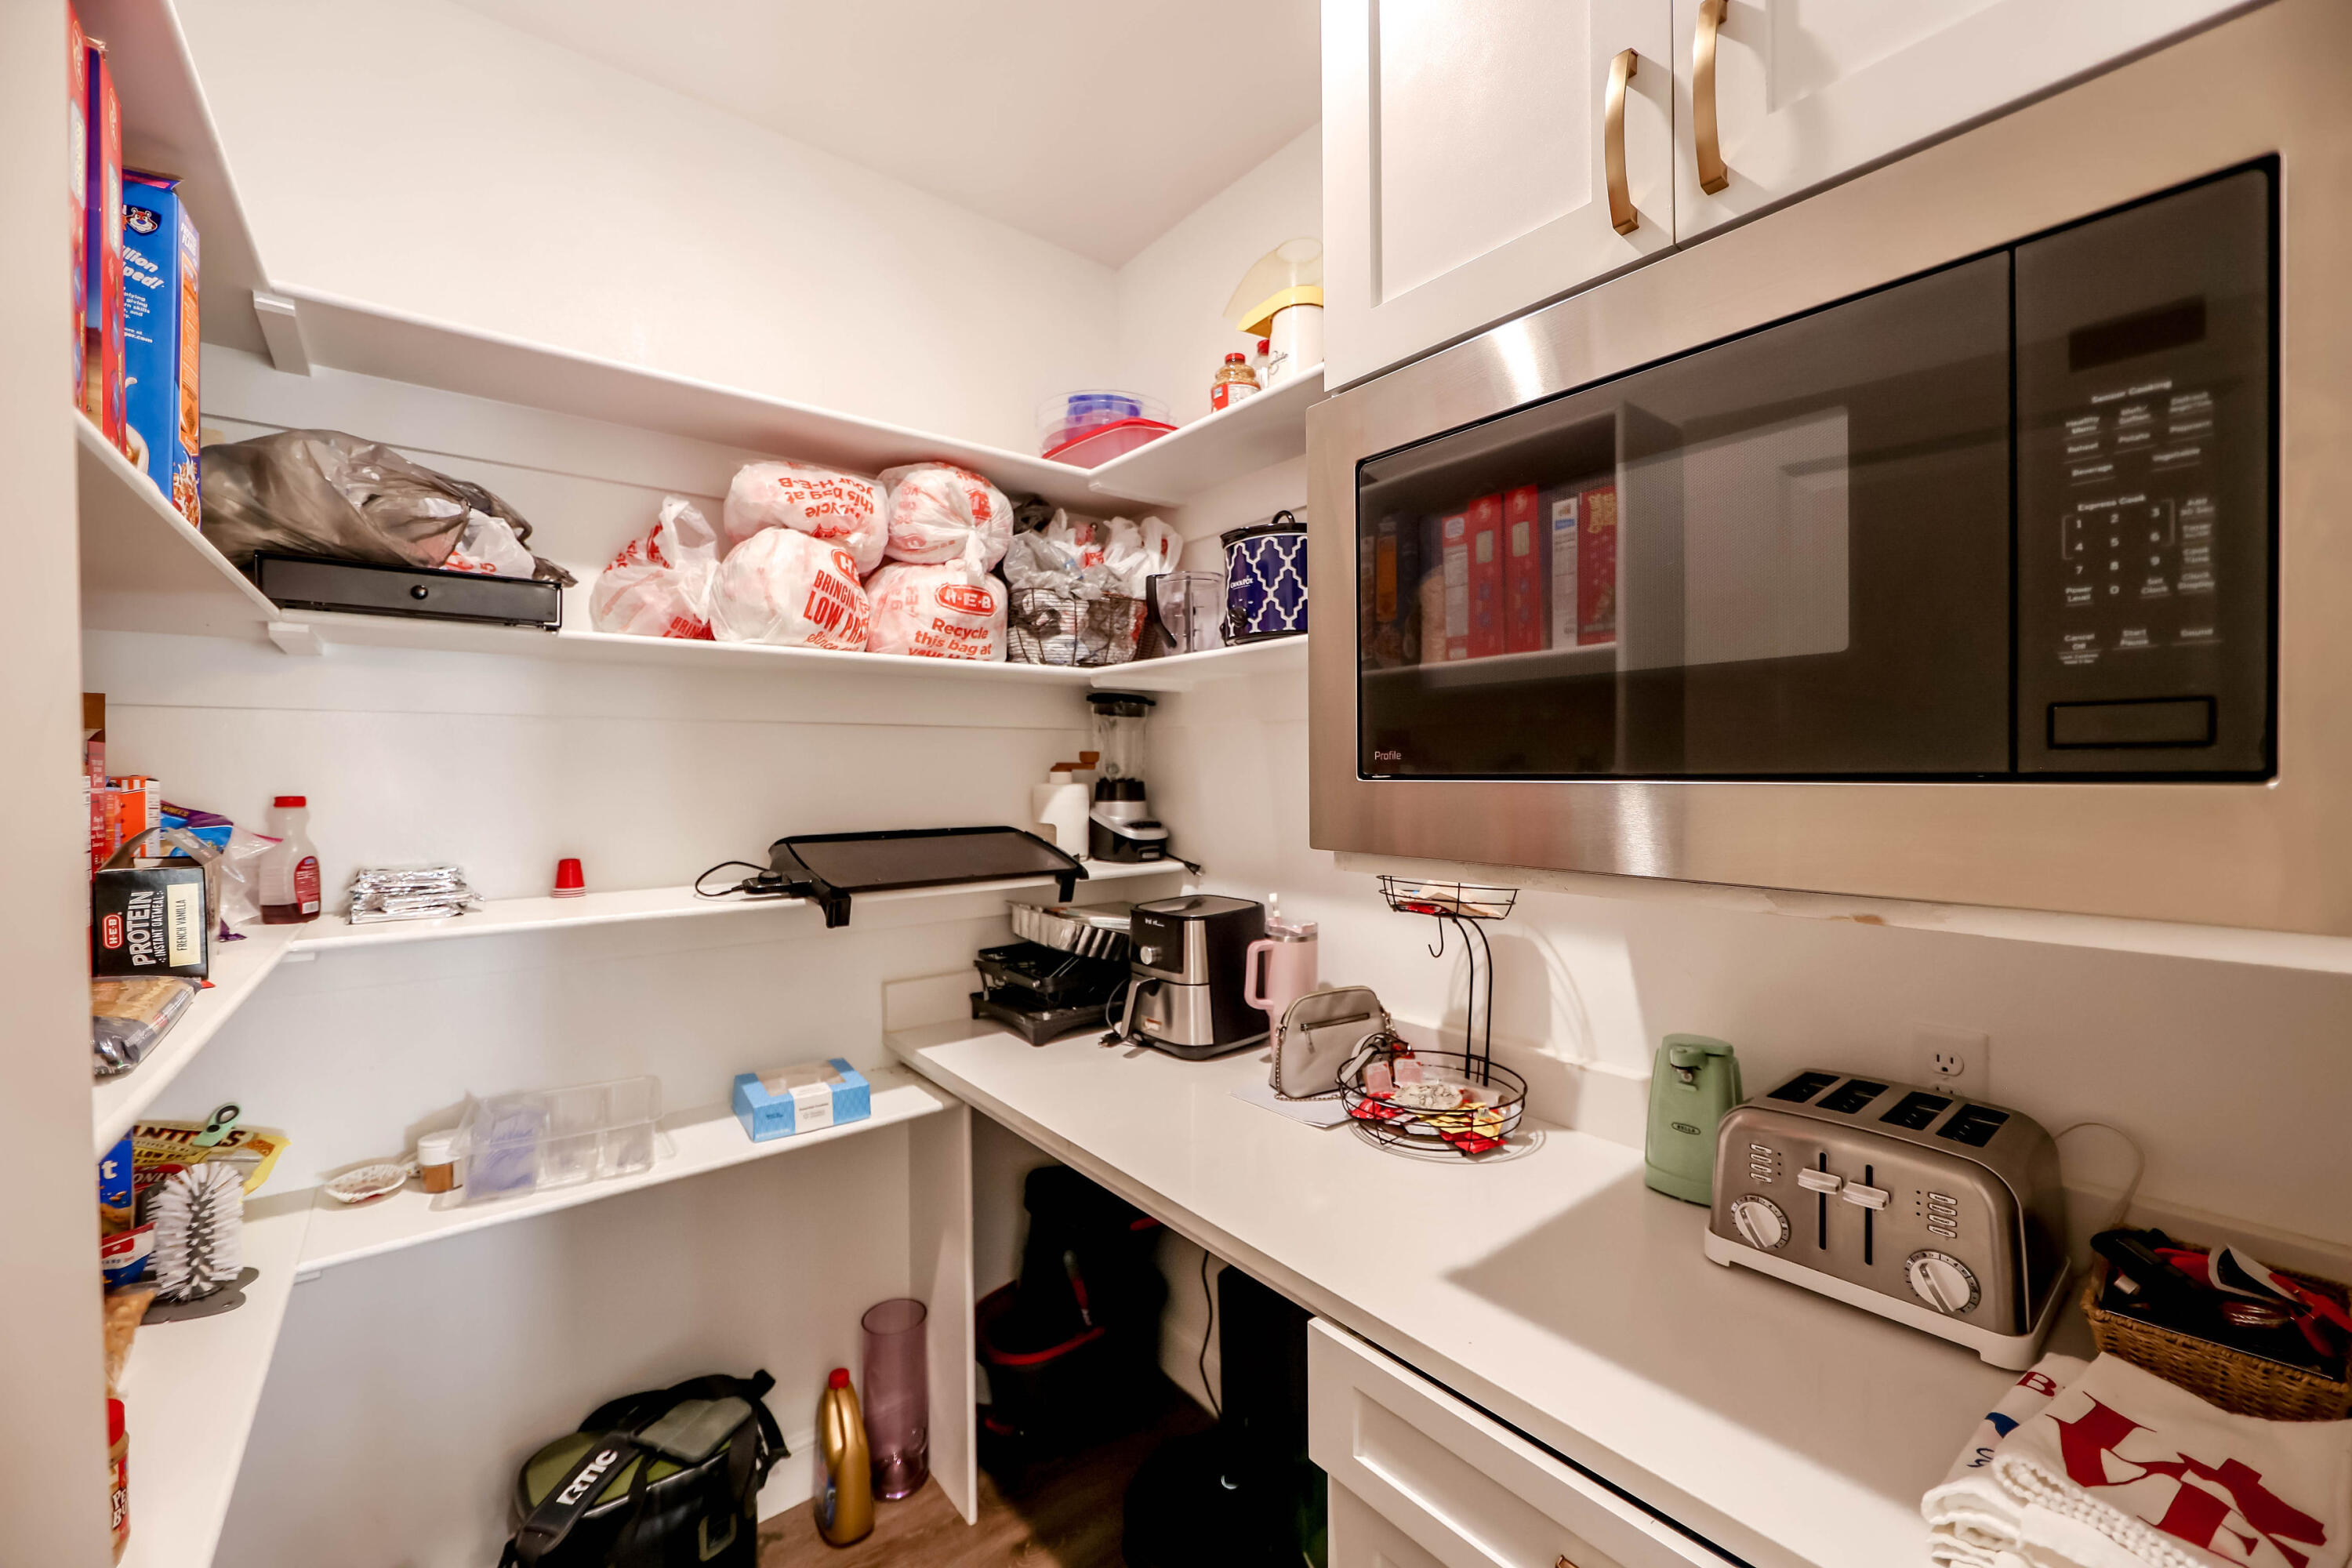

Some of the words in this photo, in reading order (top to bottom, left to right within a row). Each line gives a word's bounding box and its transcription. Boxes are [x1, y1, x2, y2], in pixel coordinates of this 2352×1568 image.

[2075, 564, 2084, 575] 7
[803, 590, 844, 633] LOW
[932, 617, 989, 641] Recycle
[914, 630, 946, 648] this
[948, 639, 978, 656] bag
[980, 643, 993, 655] at
[1374, 750, 1402, 760] Profile
[151, 895, 165, 927] OATMEAL
[175, 899, 187, 926] VANILLA
[127, 891, 157, 967] PROTEIN
[151, 928, 166, 957] INSTANT
[176, 927, 188, 952] FRENCH
[556, 1449, 619, 1505] RTIC
